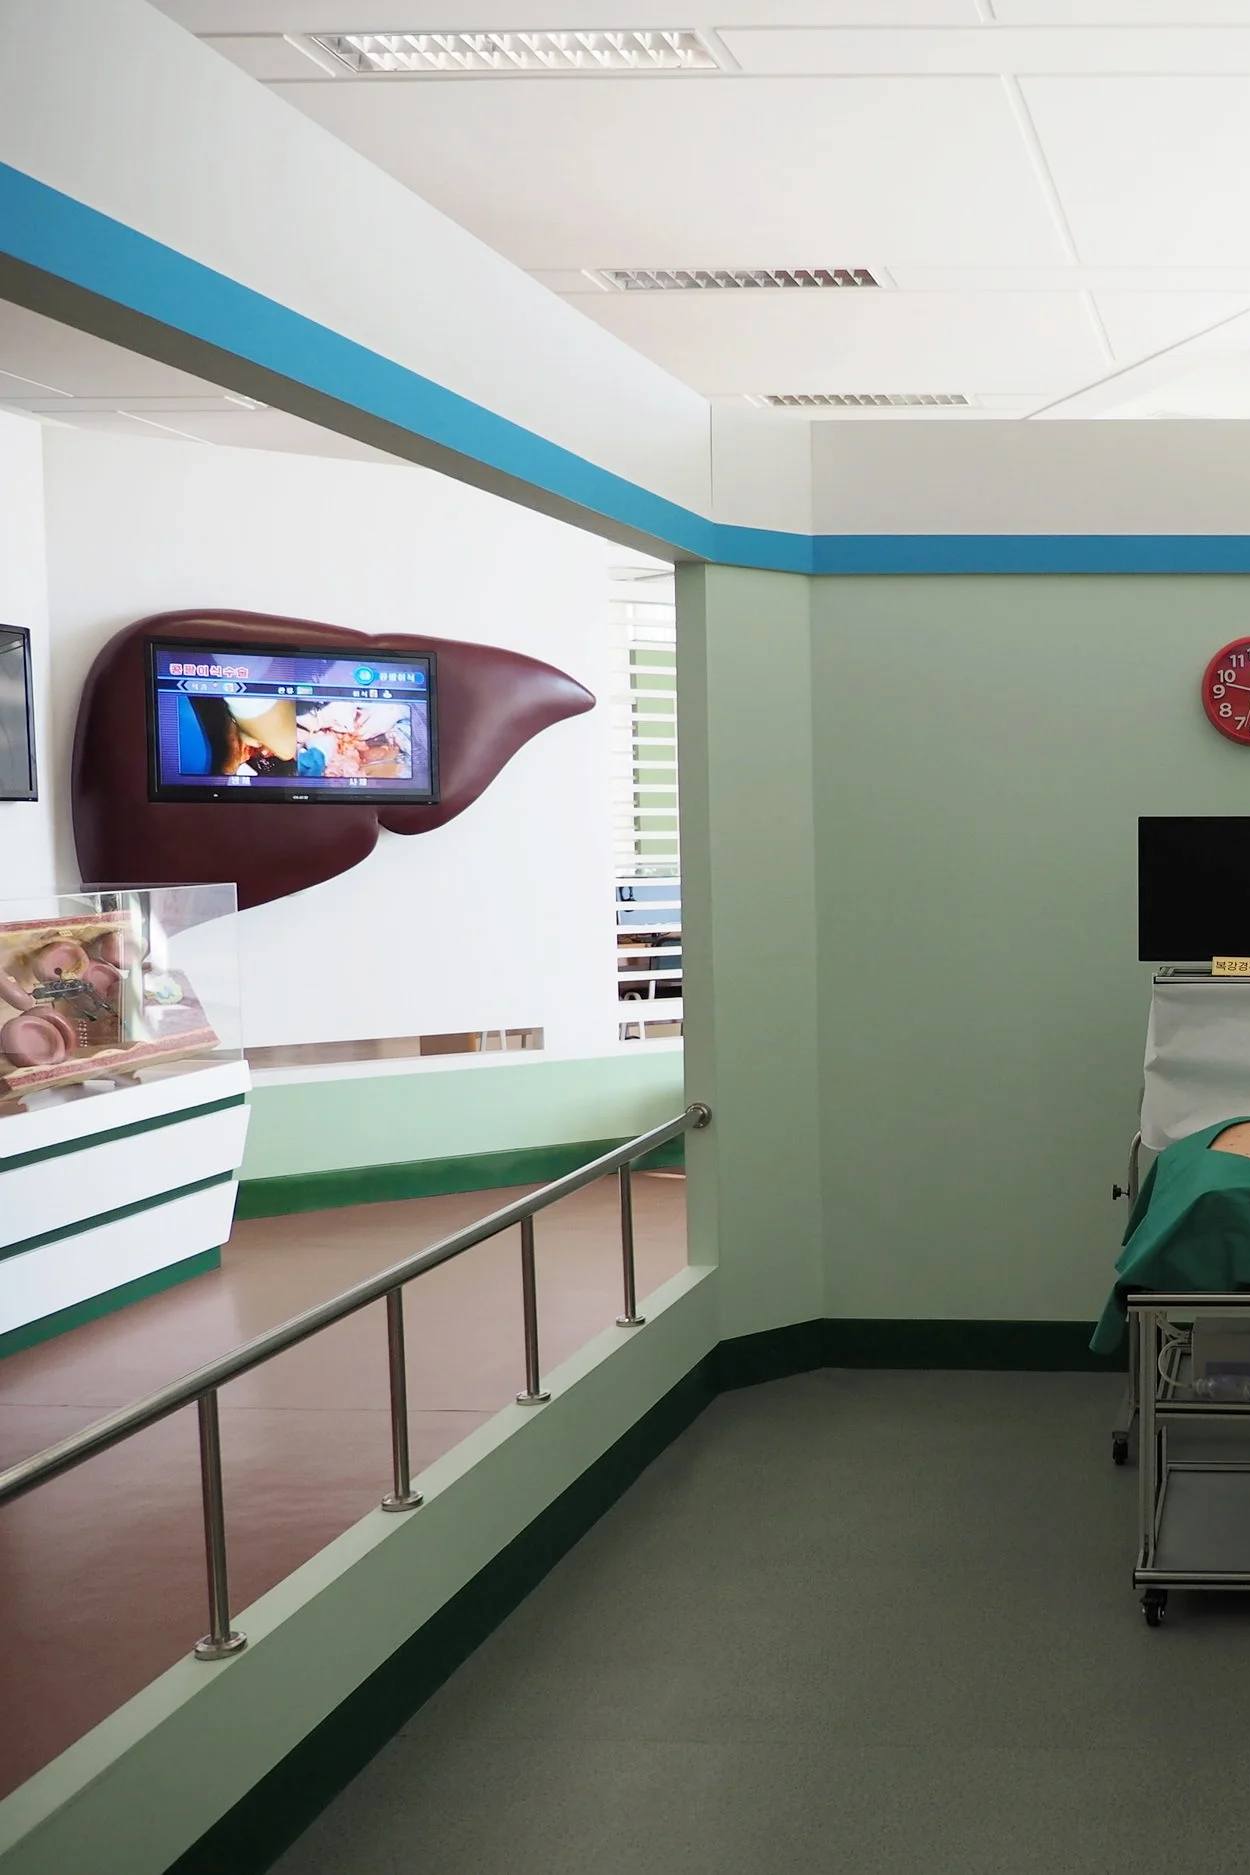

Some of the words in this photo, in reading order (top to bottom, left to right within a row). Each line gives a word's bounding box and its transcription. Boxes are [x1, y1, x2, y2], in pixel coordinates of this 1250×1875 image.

[1230, 654, 1244, 667] 11
[1217, 669, 1236, 683] 10
[1213, 684, 1225, 699] 9
[1219, 703, 1232, 717] 8
[1235, 717, 1246, 730] 7
